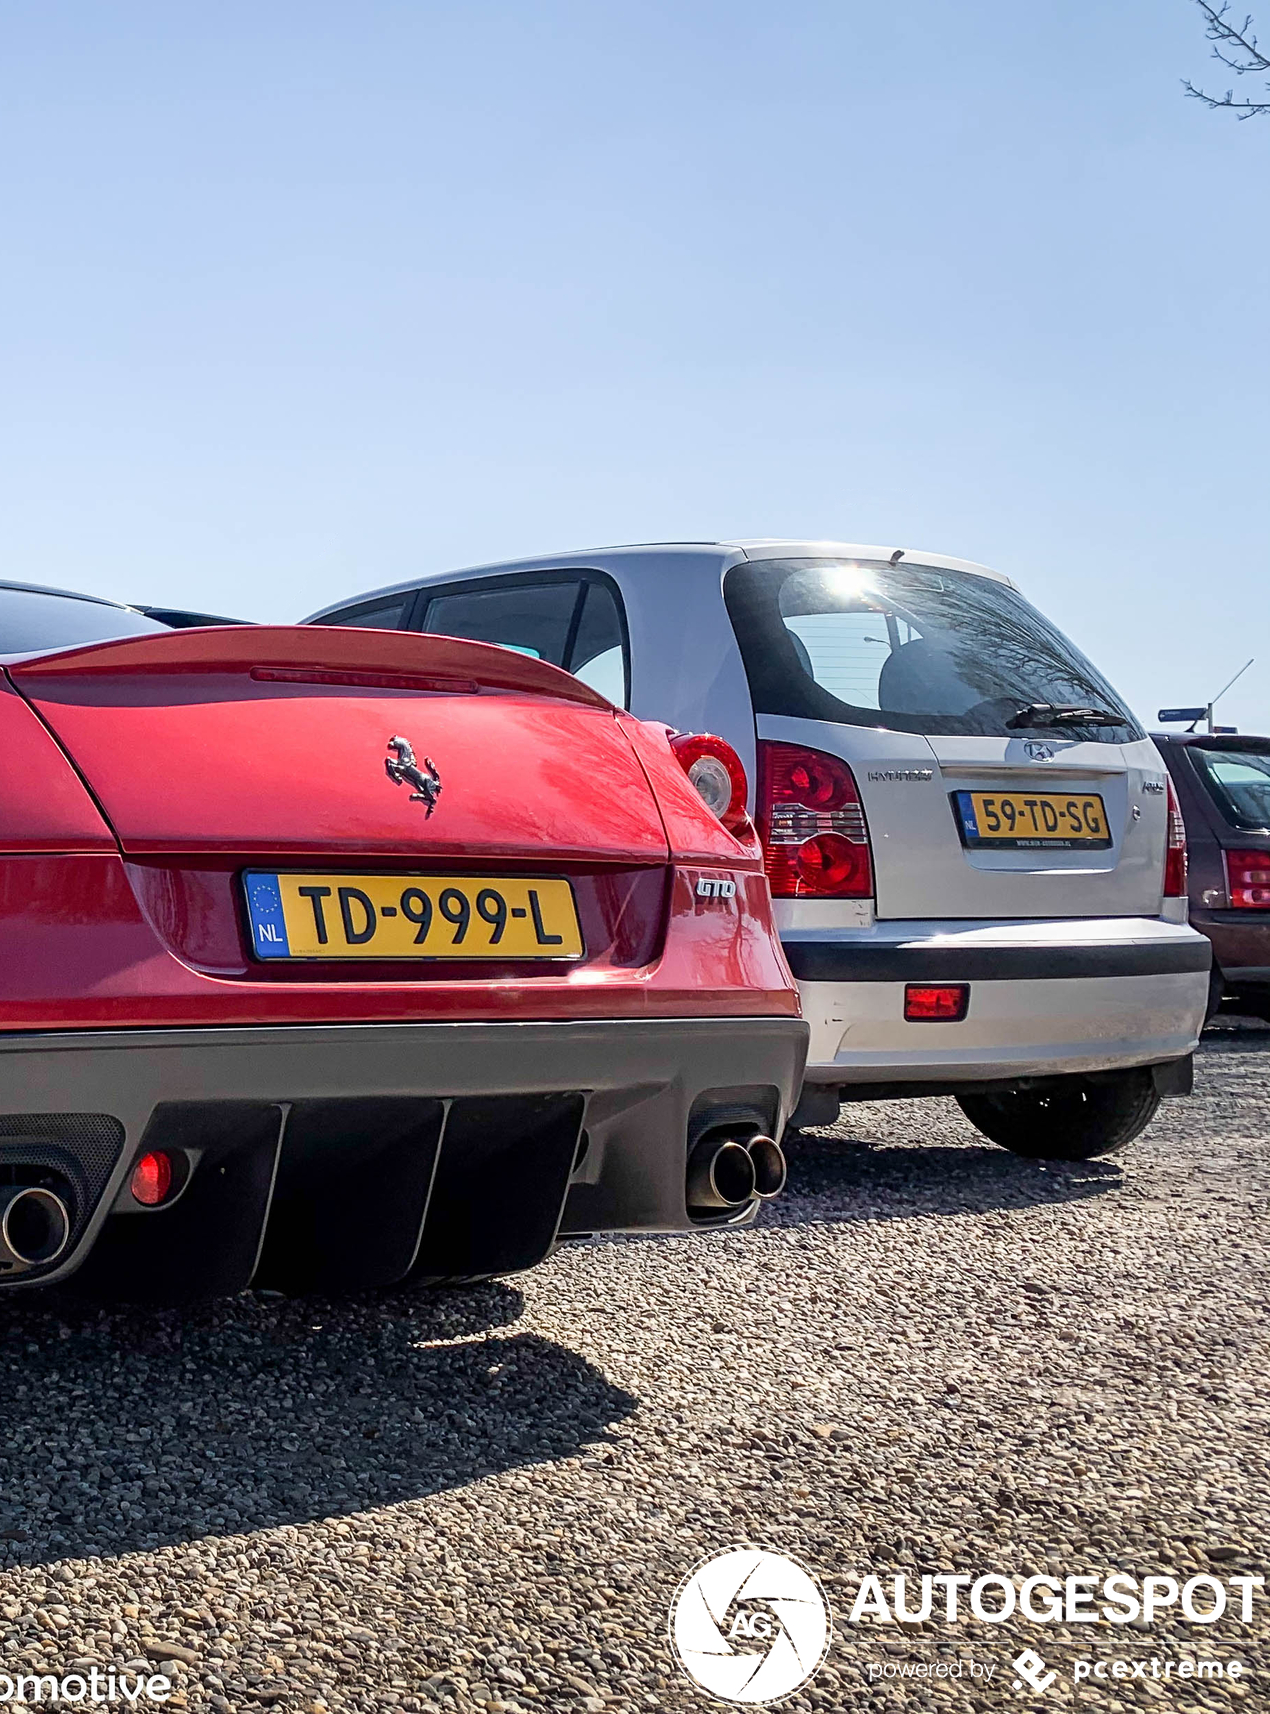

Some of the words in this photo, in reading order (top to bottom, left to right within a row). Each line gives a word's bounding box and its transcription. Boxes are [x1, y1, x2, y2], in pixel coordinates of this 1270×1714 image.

[965, 820, 977, 830] NL
[982, 799, 1101, 833] 59-TD-SG
[696, 877, 737, 897] GTO
[259, 923, 283, 943] NL
[298, 886, 564, 945] TD-999-L
